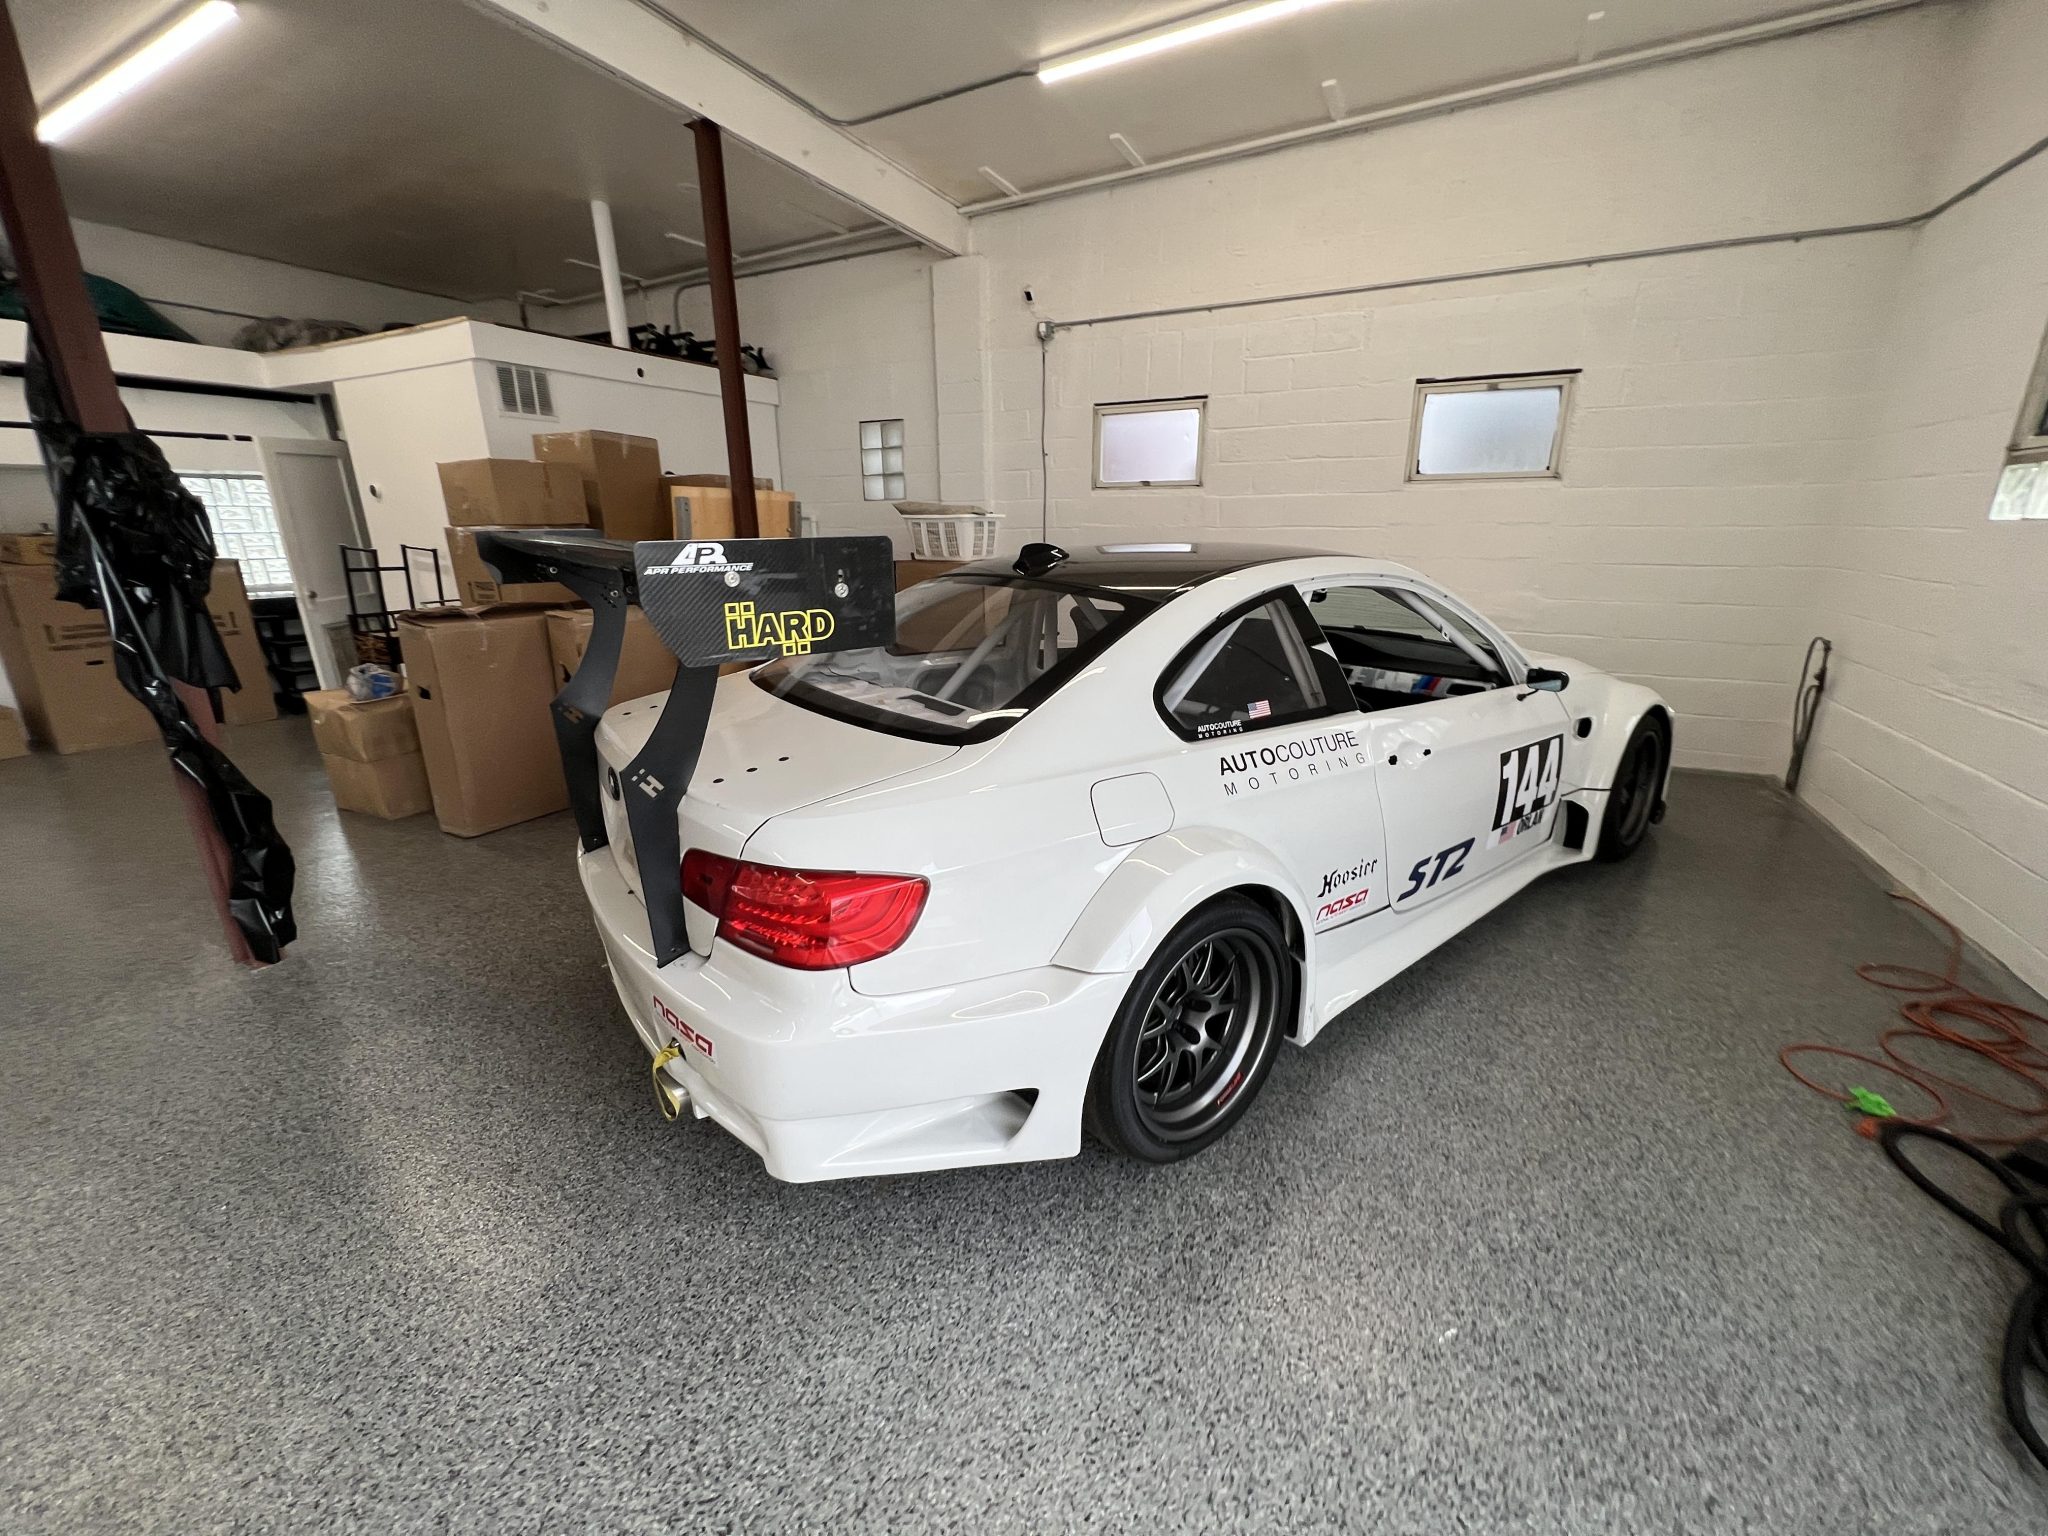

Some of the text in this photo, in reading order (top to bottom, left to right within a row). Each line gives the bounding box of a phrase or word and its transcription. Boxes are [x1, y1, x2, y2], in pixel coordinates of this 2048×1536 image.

[671, 543, 727, 565] APR
[671, 563, 753, 574] PERFORMANCE
[1197, 720, 1242, 732] AUTOCOUTURE
[1198, 727, 1243, 738] MOTORING
[1220, 731, 1360, 776] AUTOCOUTURE
[1223, 752, 1366, 797] MOTORING
[1500, 737, 1560, 826] 144
[1317, 858, 1378, 898] Hoosier
